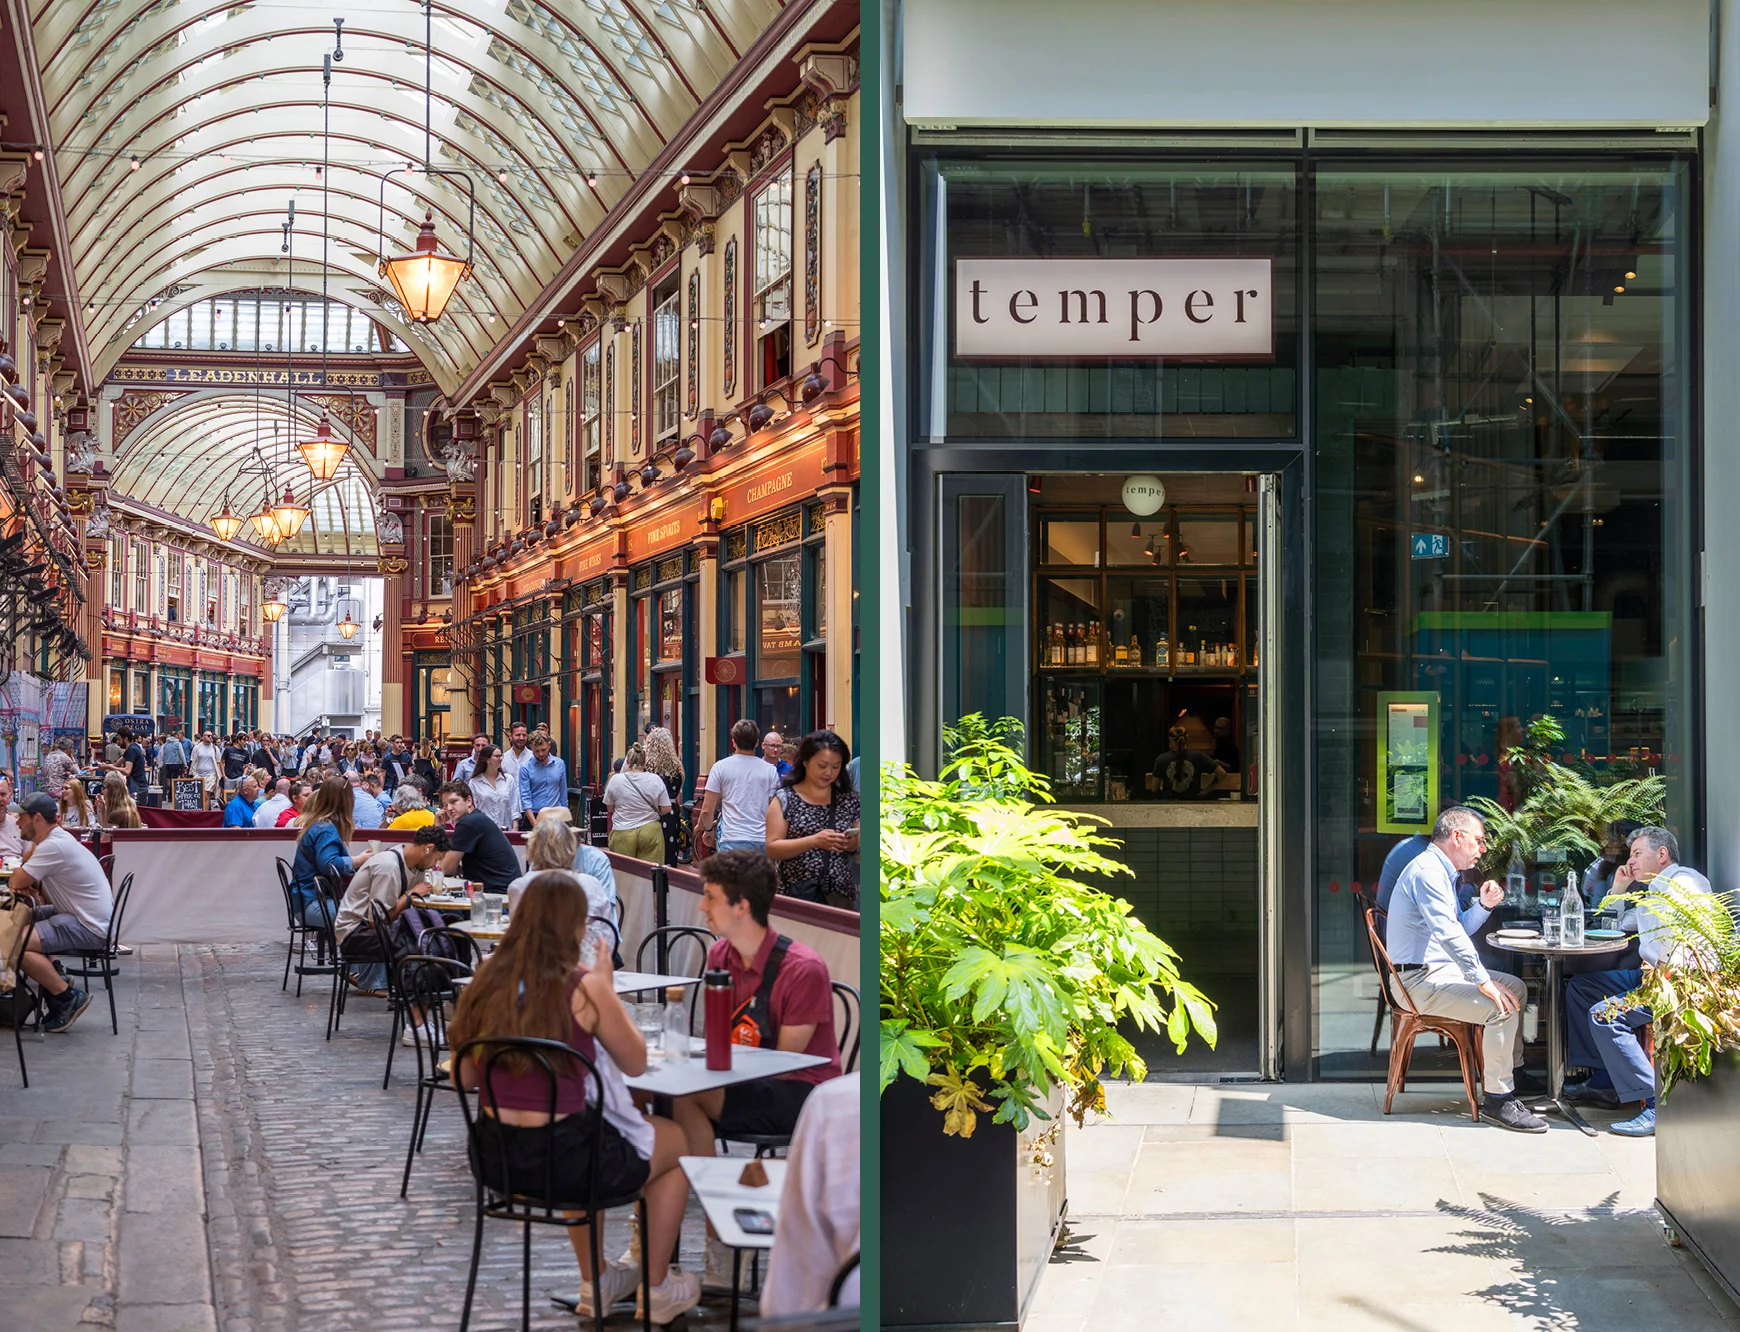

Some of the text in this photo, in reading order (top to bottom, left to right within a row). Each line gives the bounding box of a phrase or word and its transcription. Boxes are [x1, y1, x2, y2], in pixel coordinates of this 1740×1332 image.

[968, 279, 1258, 342] temper
[173, 368, 321, 385] LEADENHALL
[747, 471, 793, 504] CHAMPAGNE
